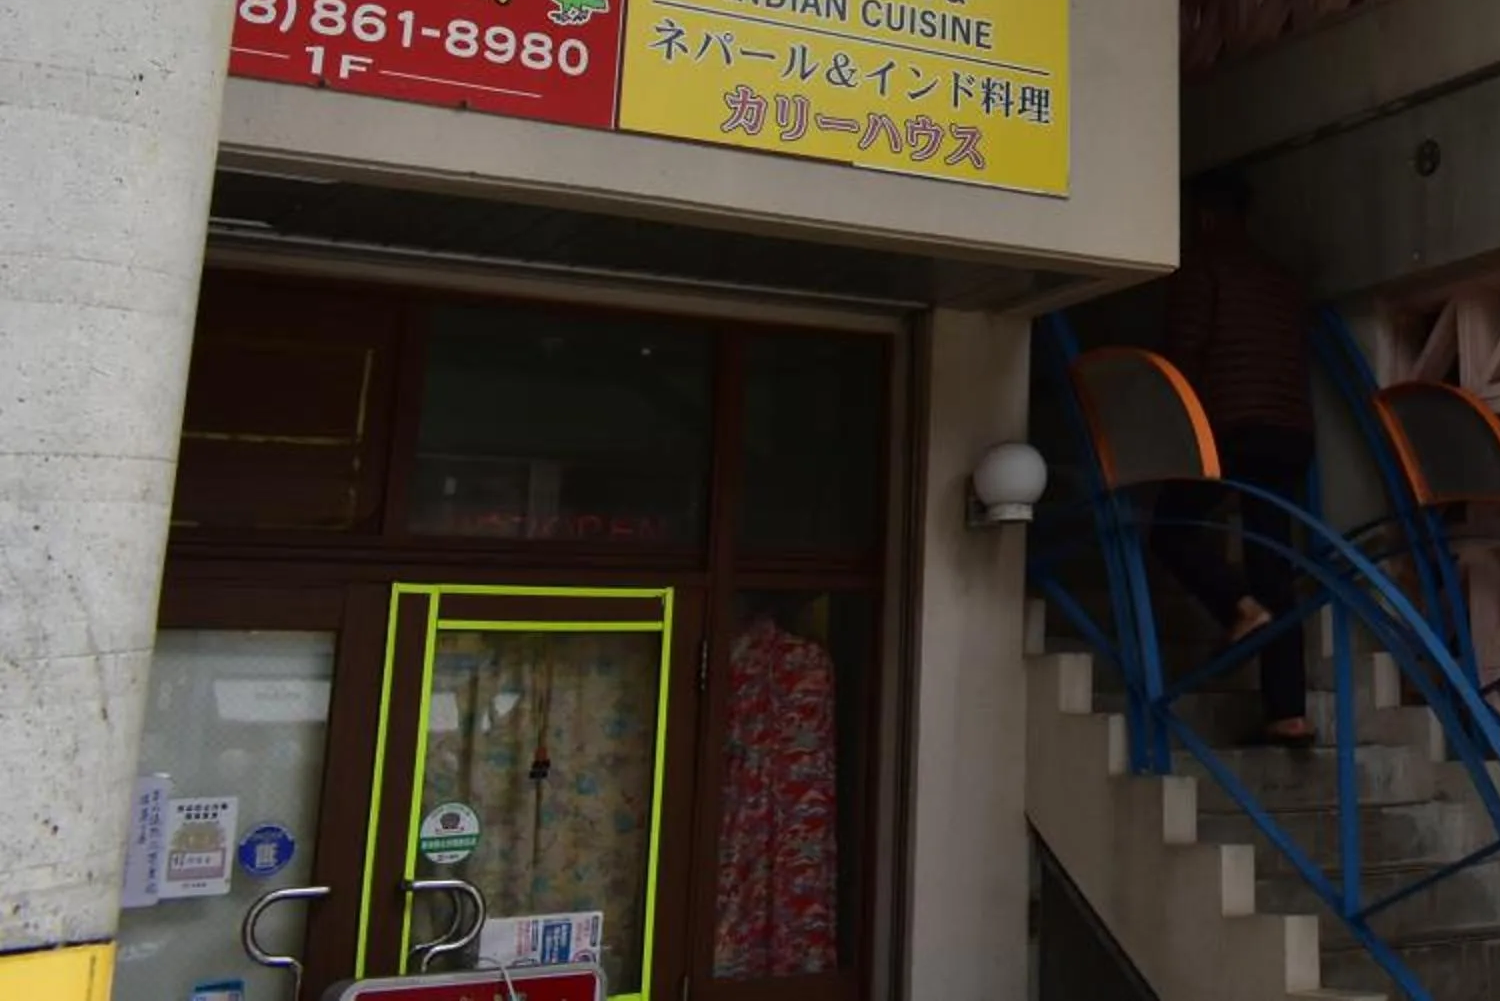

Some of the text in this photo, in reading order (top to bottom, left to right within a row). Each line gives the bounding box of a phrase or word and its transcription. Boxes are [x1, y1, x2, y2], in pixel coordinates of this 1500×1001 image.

[304, 45, 374, 80] 1F
[720, 85, 986, 170] カリーハウス
